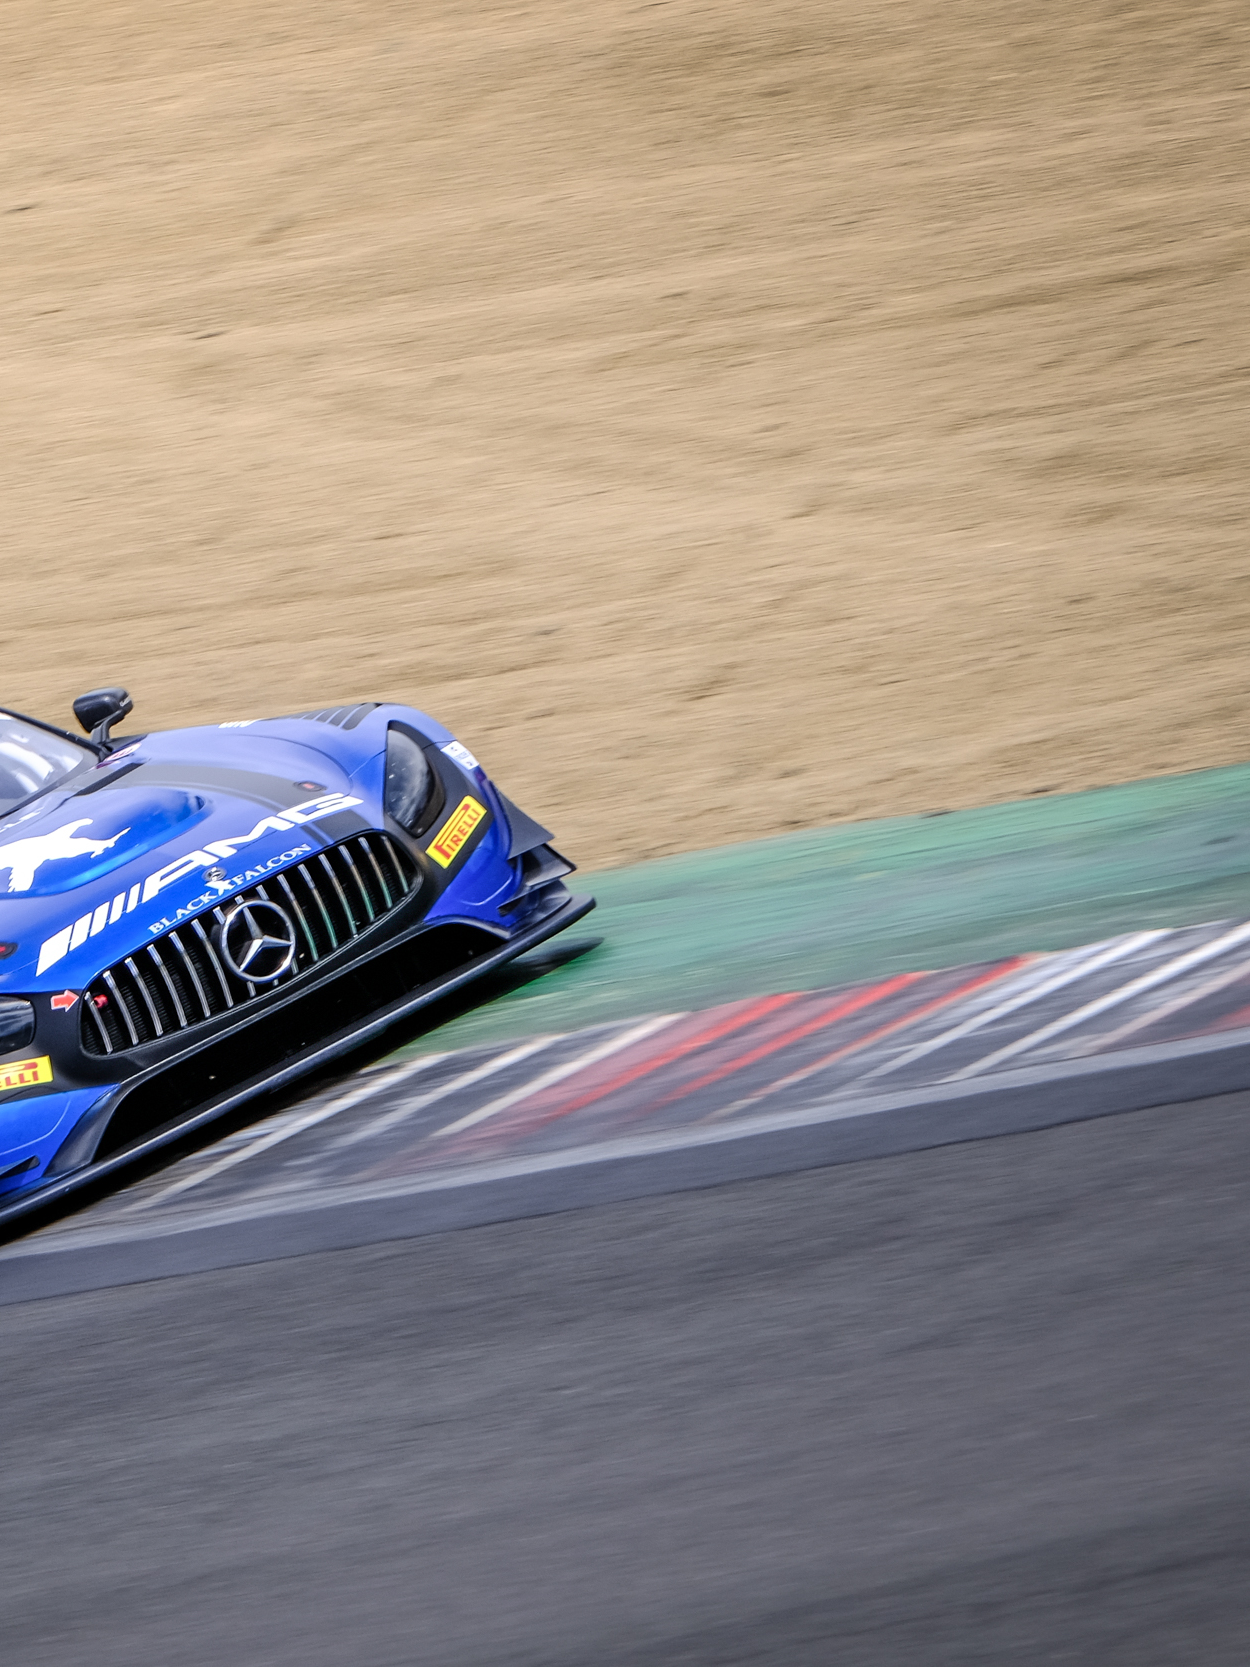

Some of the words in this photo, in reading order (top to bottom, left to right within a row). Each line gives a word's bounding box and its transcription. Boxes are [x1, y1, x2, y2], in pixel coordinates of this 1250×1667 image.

[143, 792, 365, 904] AMG
[433, 803, 481, 860] PIRELLI
[148, 887, 219, 936] BLACK
[227, 843, 313, 893] FALCON
